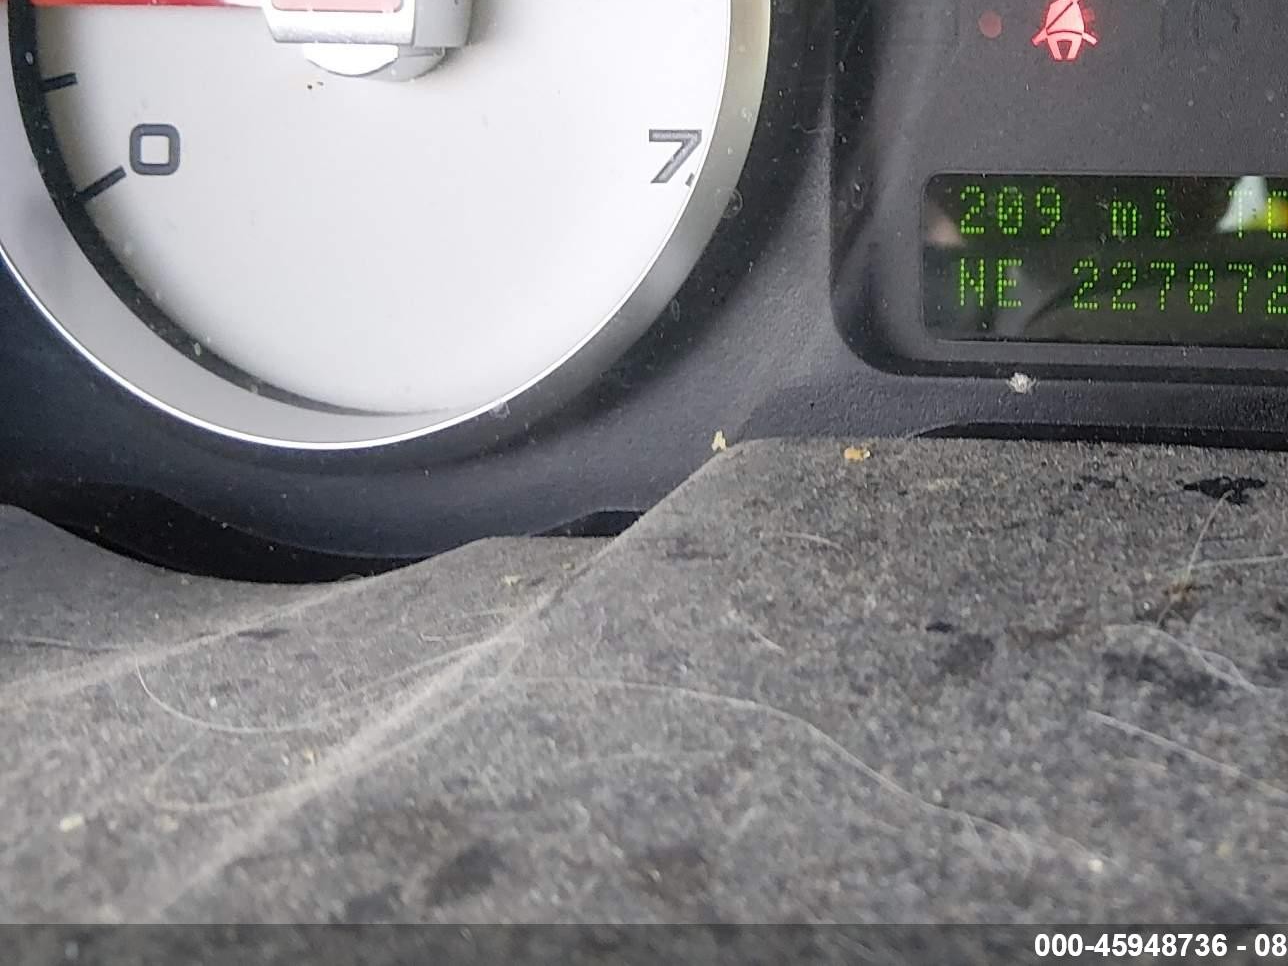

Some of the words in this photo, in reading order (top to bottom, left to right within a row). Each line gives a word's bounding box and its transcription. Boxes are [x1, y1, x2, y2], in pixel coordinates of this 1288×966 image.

[129, 123, 181, 177] 0
[649, 129, 703, 184] 7
[959, 186, 1064, 237] 209
[1110, 189, 1171, 240] mi
[957, 258, 1024, 311] NE
